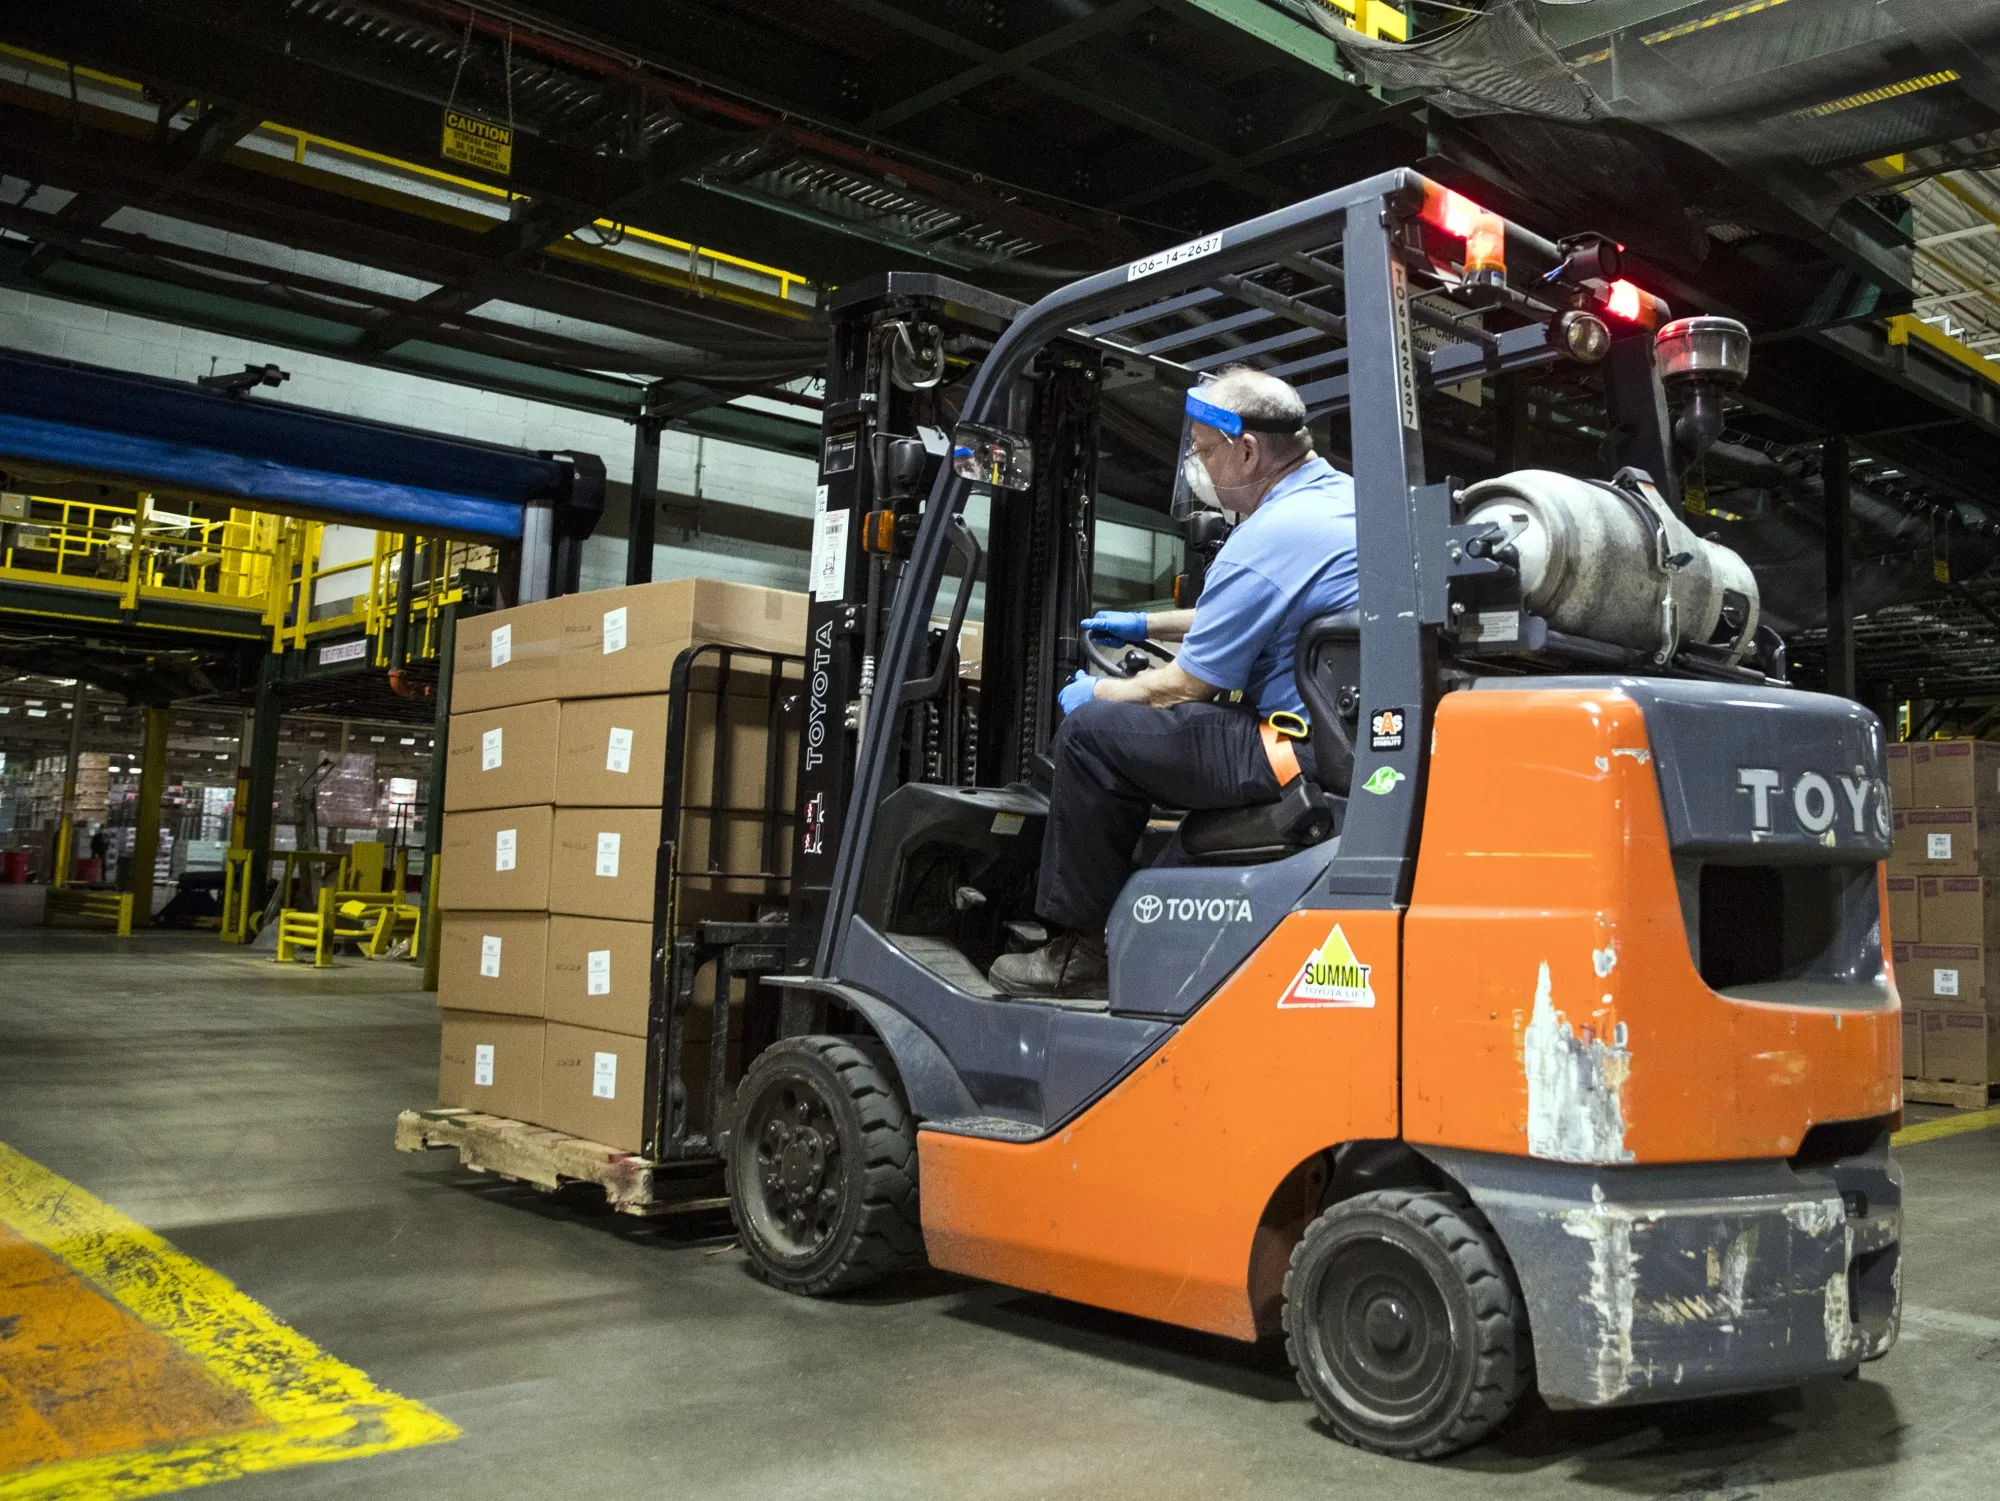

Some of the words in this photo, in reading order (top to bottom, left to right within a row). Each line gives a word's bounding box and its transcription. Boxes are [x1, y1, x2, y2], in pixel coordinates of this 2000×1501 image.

[447, 113, 509, 144] CAUTION
[453, 131, 482, 147] STORAGE
[483, 140, 502, 153] MUST
[475, 146, 499, 161] INCHES
[446, 147, 468, 159] BELOW
[468, 154, 508, 170] SPRINKLERS
[825, 524, 843, 535] SUMMIT
[806, 620, 834, 771] TOYOTA
[1372, 711, 1403, 736] SAS
[1166, 897, 1253, 923] TOYOTA
[1304, 962, 1370, 989] SUMMIT
[1305, 986, 1342, 998] TOYOTA
[1345, 988, 1367, 999] LIFT
